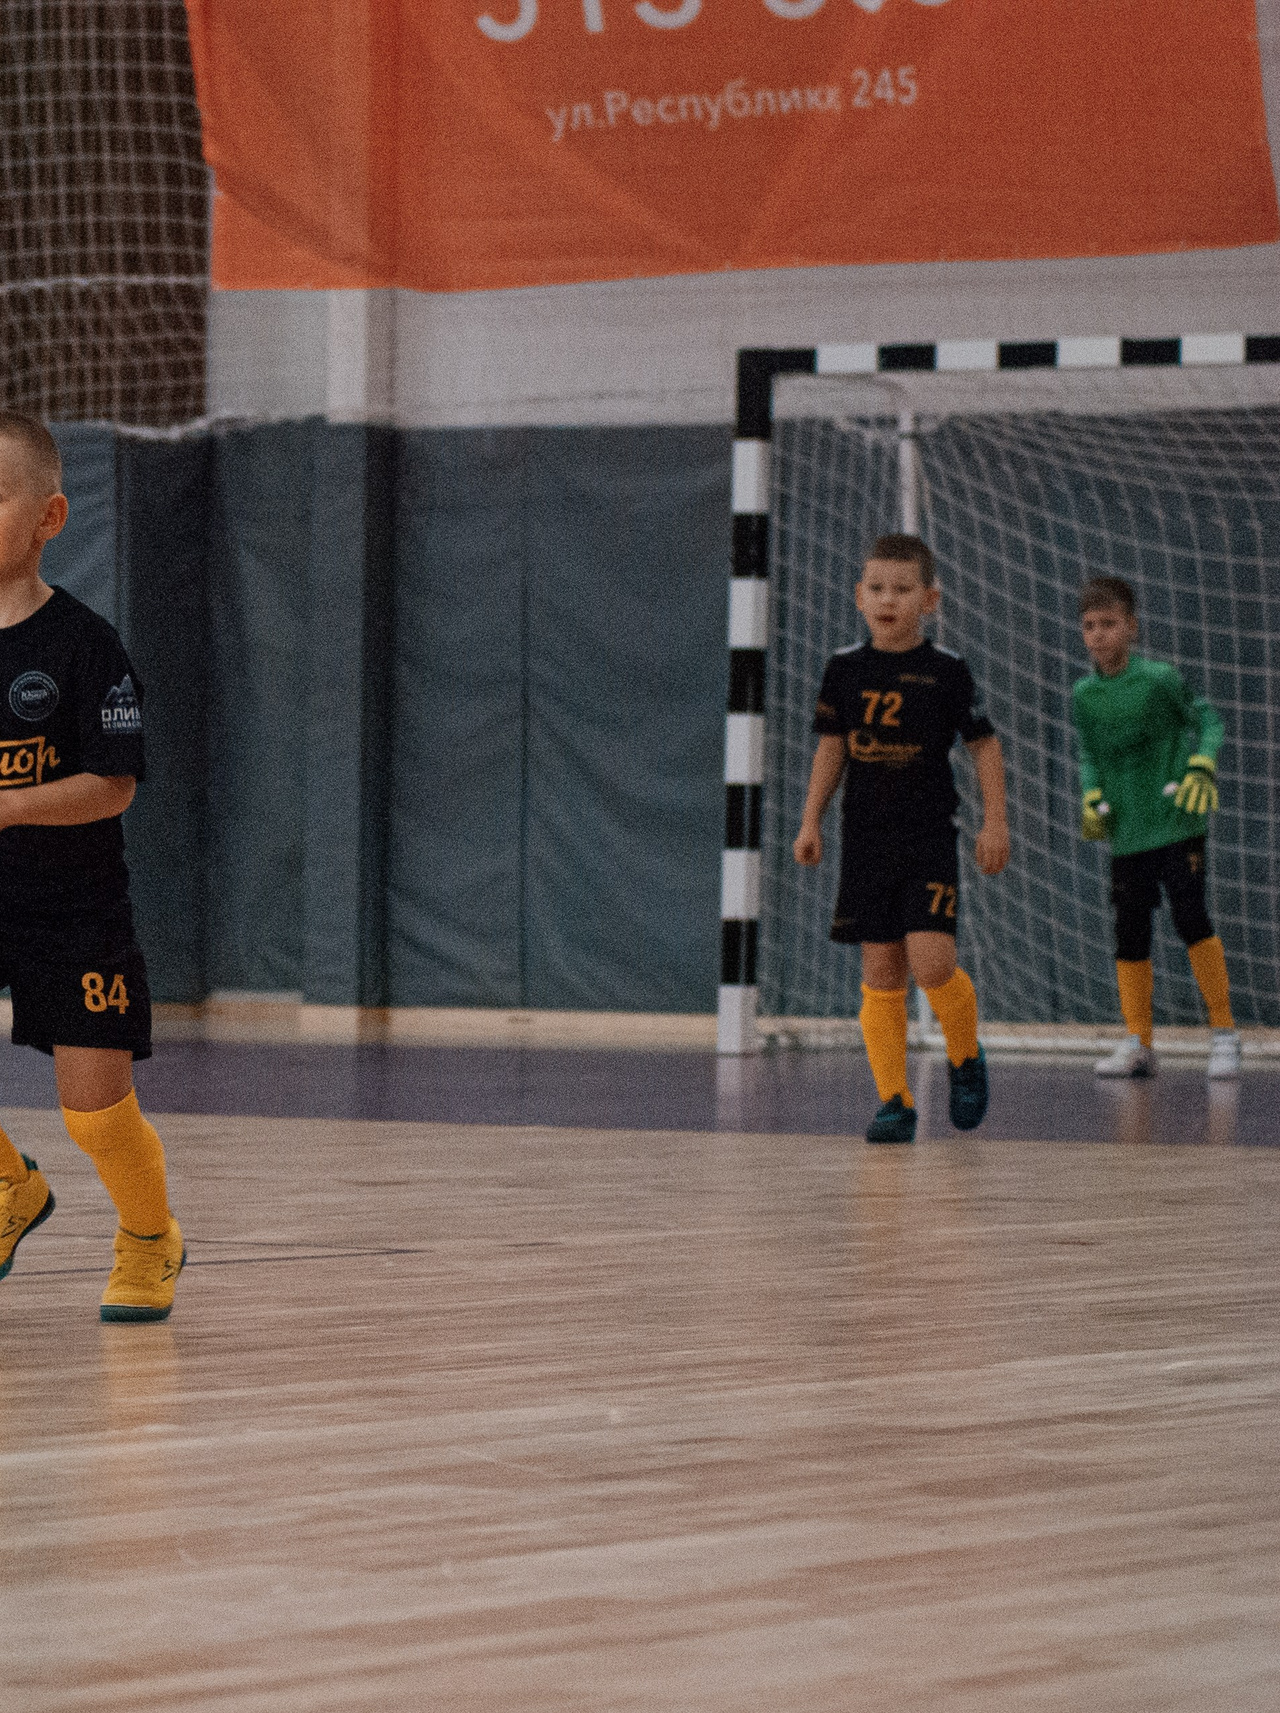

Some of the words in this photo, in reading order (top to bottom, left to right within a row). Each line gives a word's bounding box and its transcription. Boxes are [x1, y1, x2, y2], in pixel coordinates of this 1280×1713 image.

[850, 65, 918, 107] 245
[861, 689, 903, 727] 72
[81, 971, 130, 1015] 84
